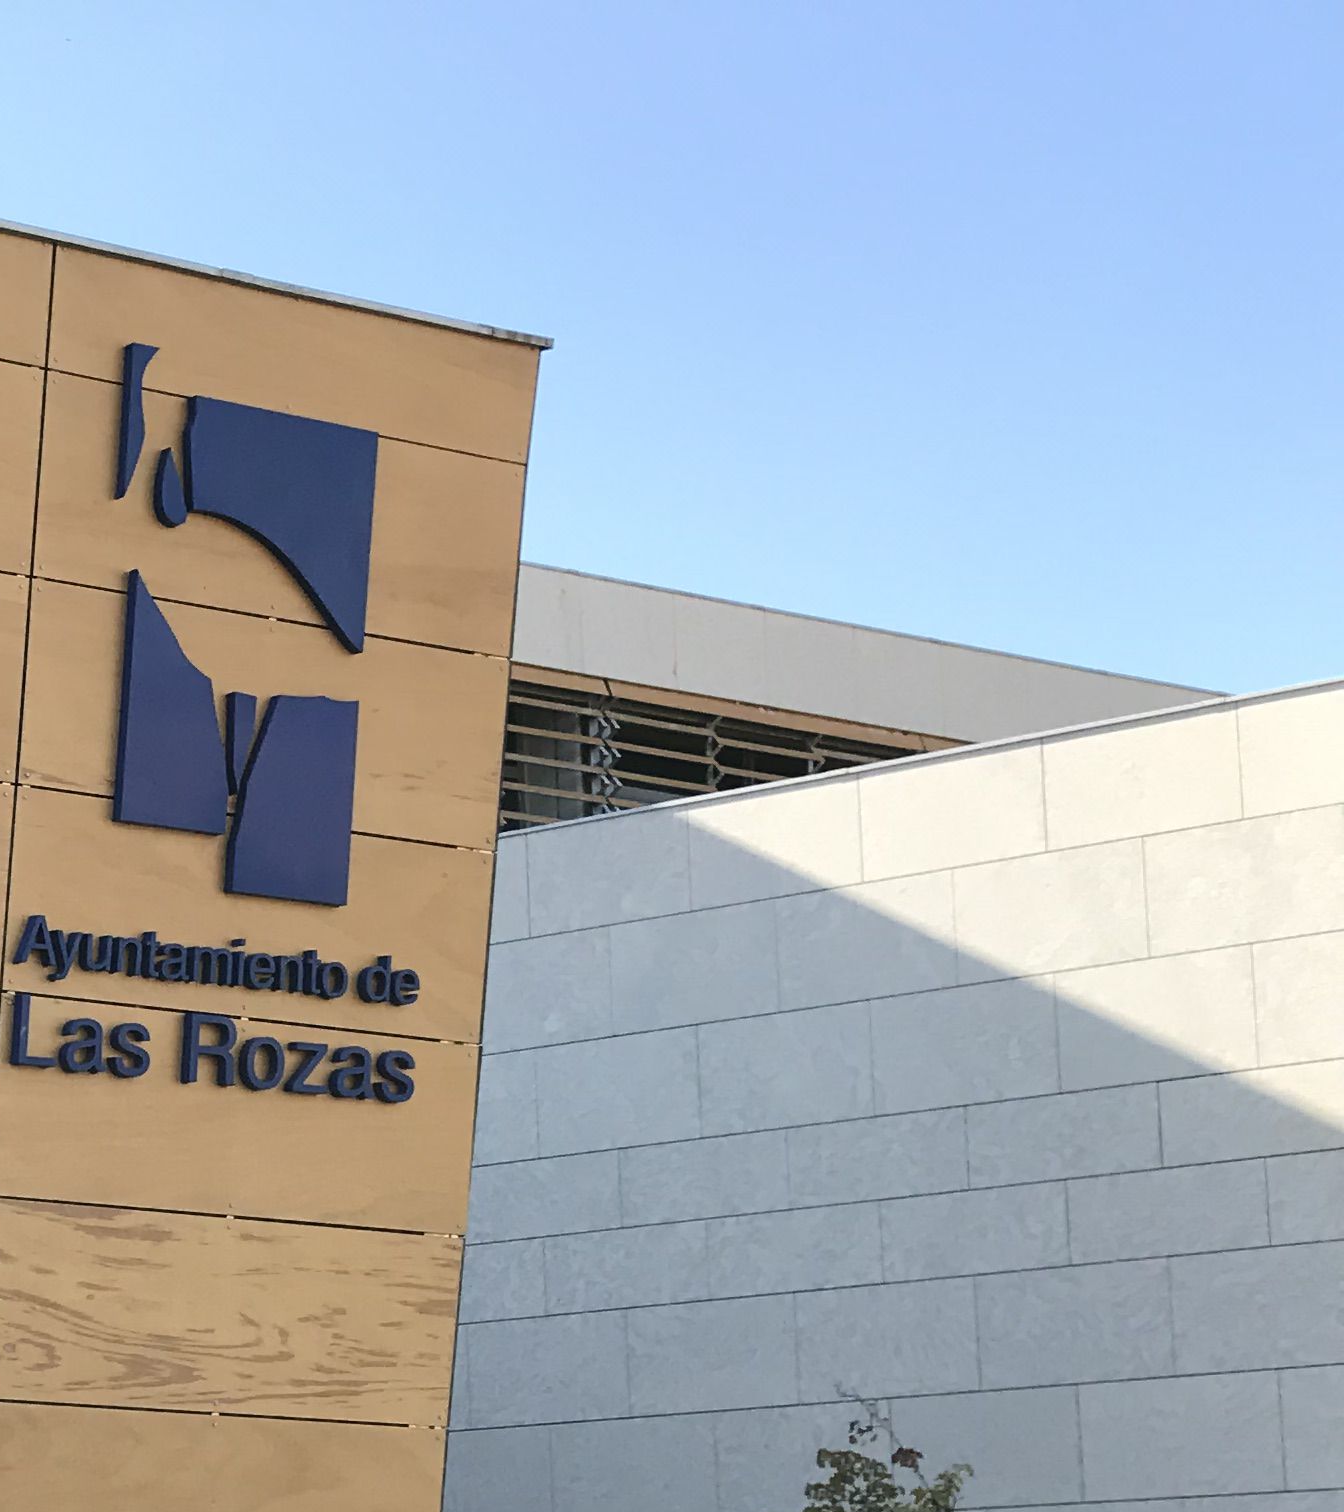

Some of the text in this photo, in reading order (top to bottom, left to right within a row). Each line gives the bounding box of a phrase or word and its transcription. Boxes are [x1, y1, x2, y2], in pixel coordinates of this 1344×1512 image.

[12, 914, 421, 1007] Ayuntamiento de
[9, 992, 416, 1104] Las Rozas
